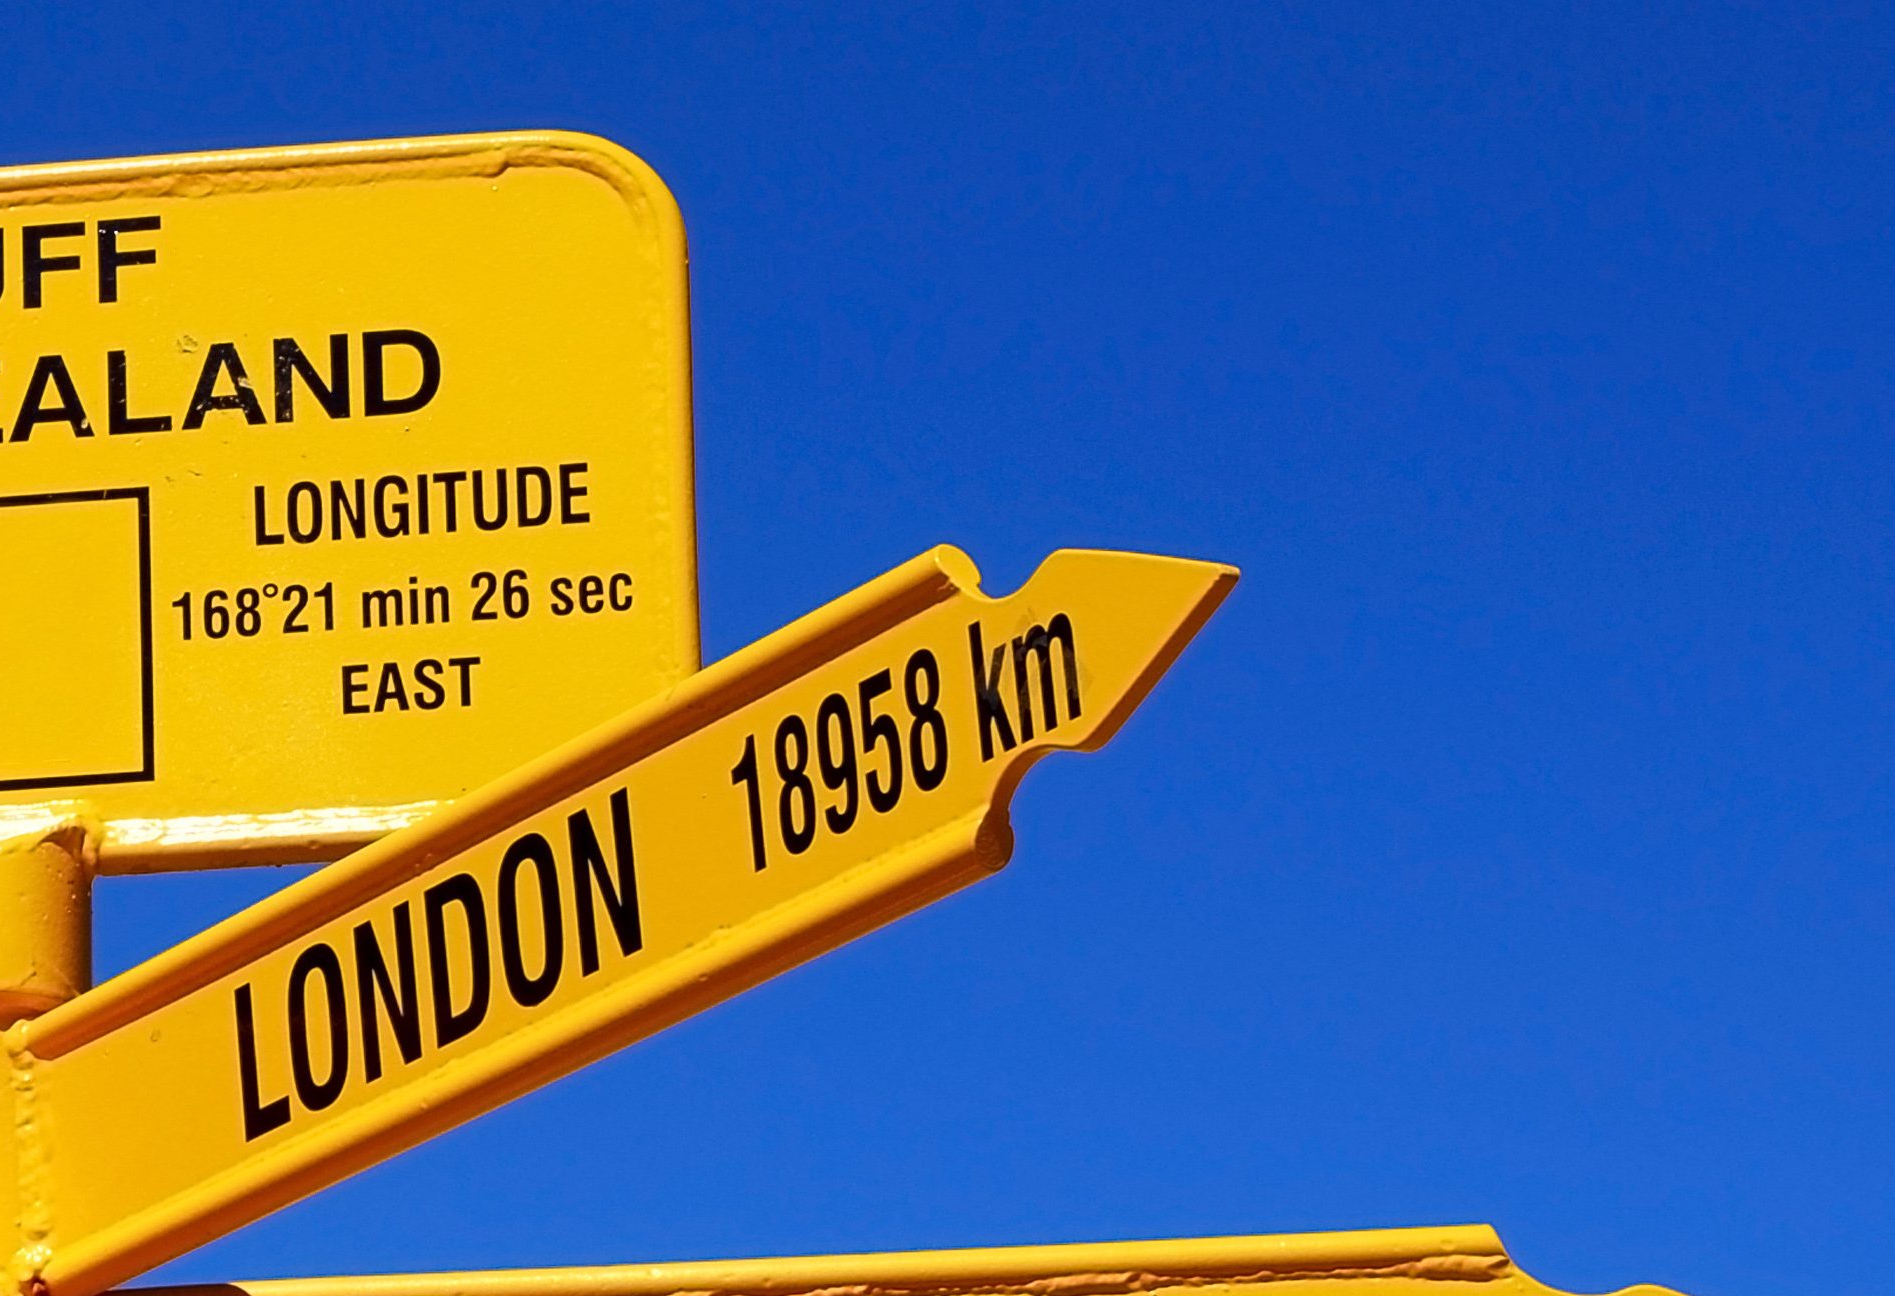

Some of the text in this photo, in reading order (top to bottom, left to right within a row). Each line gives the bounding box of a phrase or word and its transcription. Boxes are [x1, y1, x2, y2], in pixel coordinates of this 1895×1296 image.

[254, 462, 590, 546] LONGITUDE
[172, 569, 633, 641] 168°21 min 26 sec
[342, 657, 482, 715] EAST
[234, 613, 1083, 1142] LONDON 18958 km
